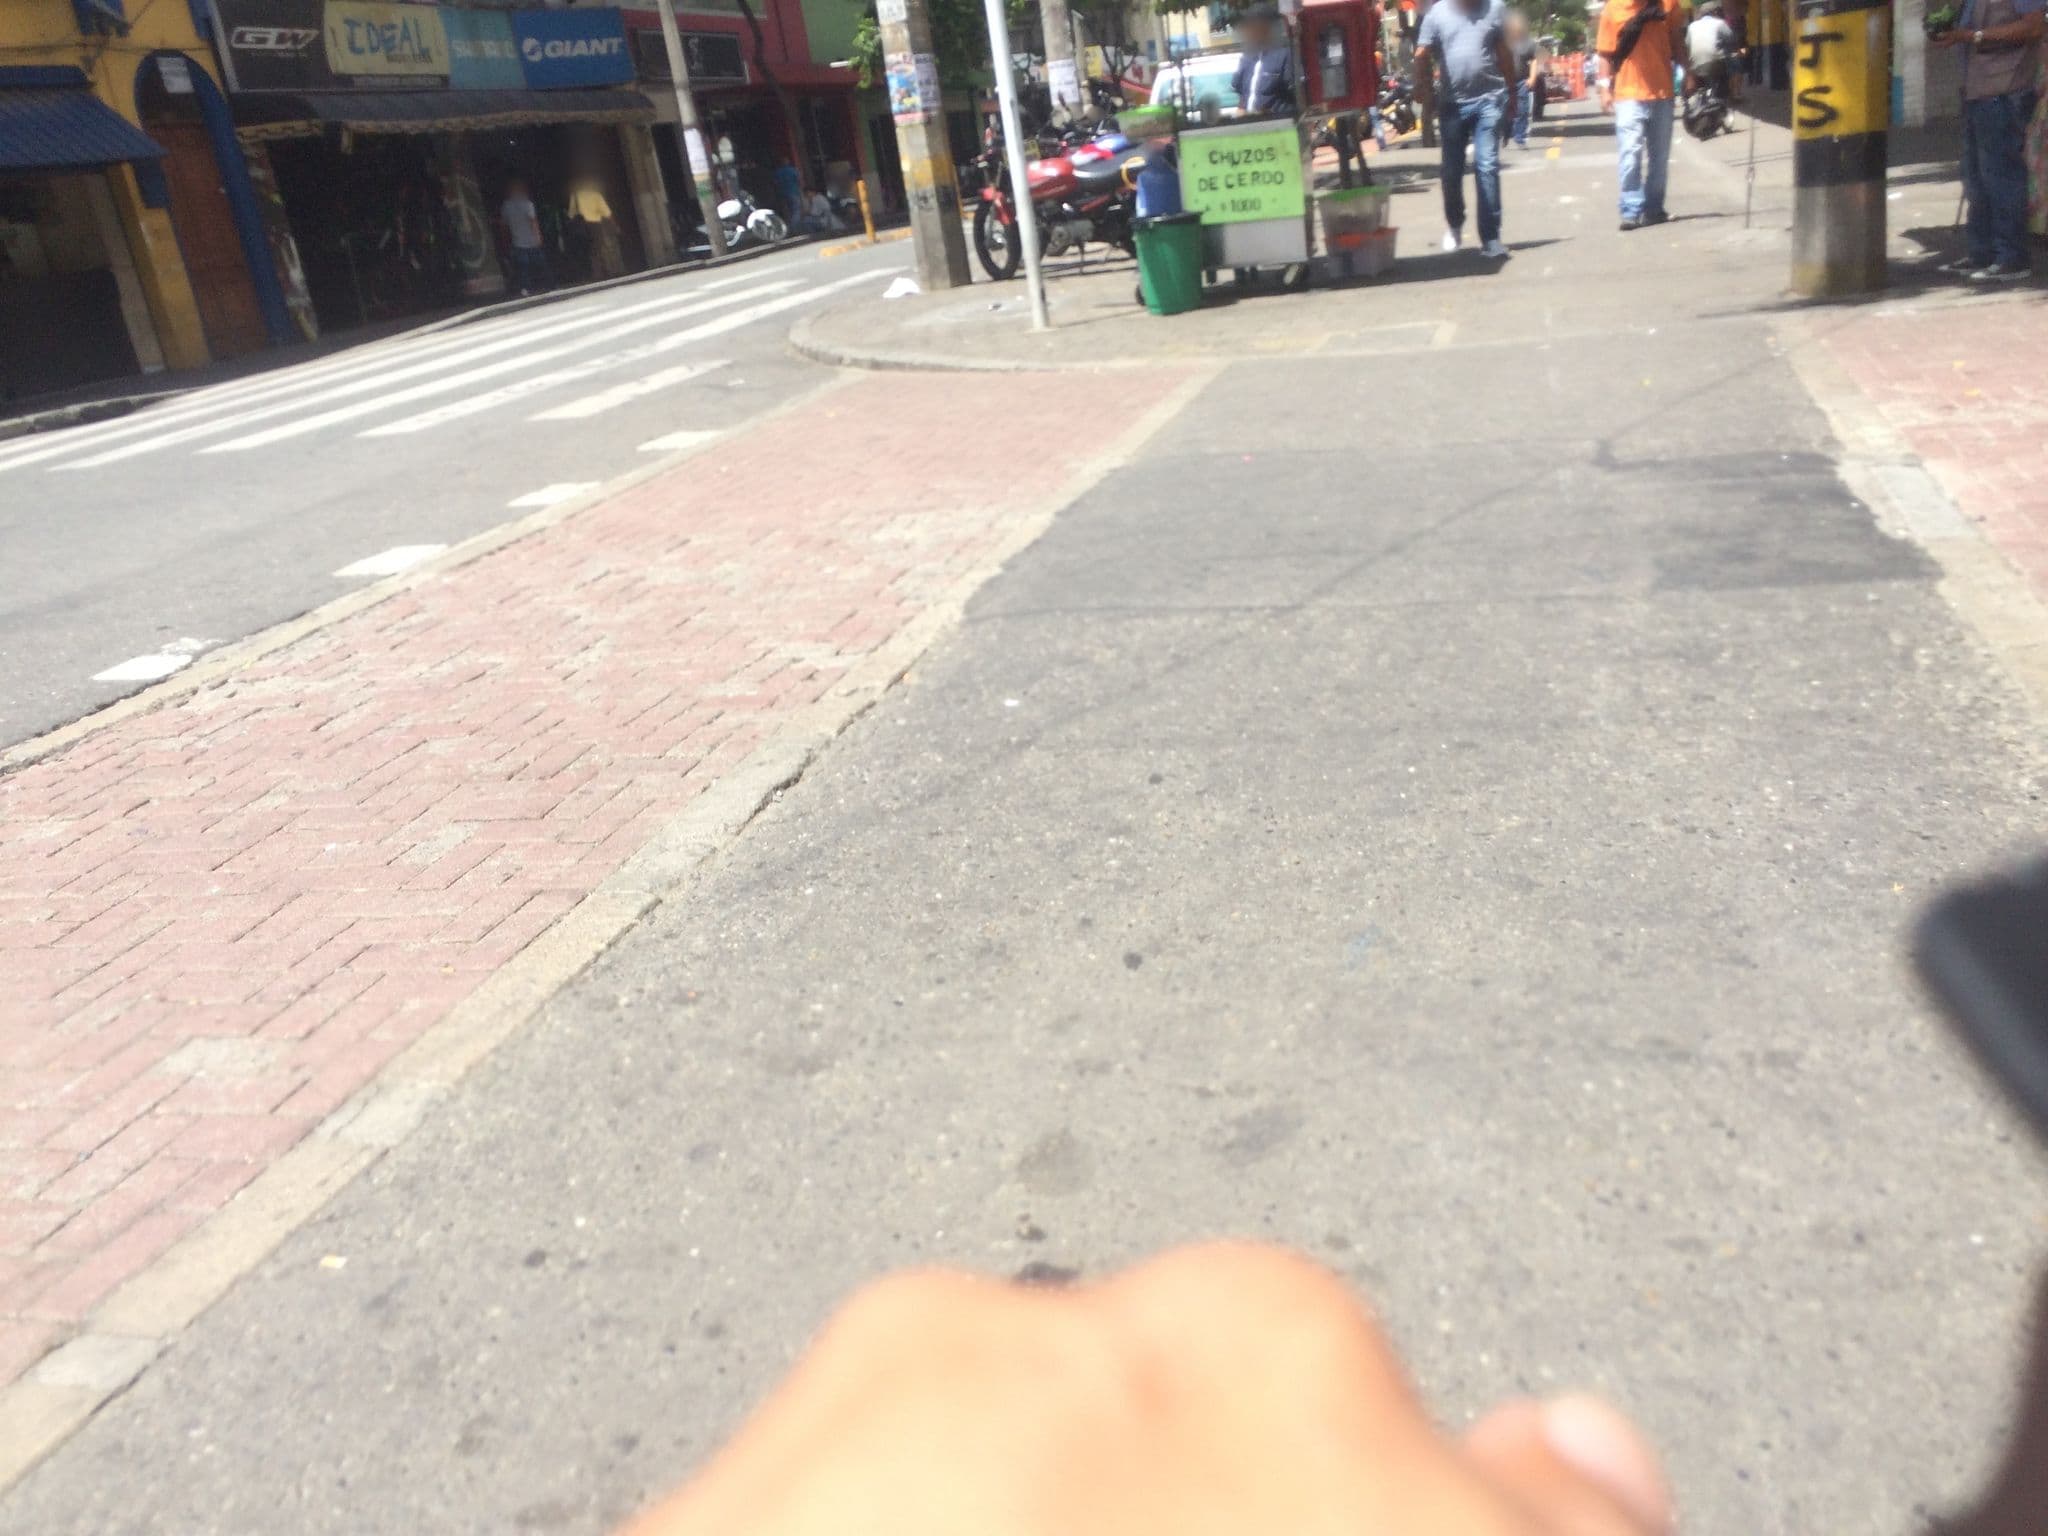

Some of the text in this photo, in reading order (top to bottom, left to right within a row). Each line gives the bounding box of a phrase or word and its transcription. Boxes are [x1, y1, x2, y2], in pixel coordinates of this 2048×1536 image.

[545, 37, 622, 58] GIANT
[1208, 147, 1276, 167] CHUZOS
[1198, 170, 1284, 192] DE CERDO
